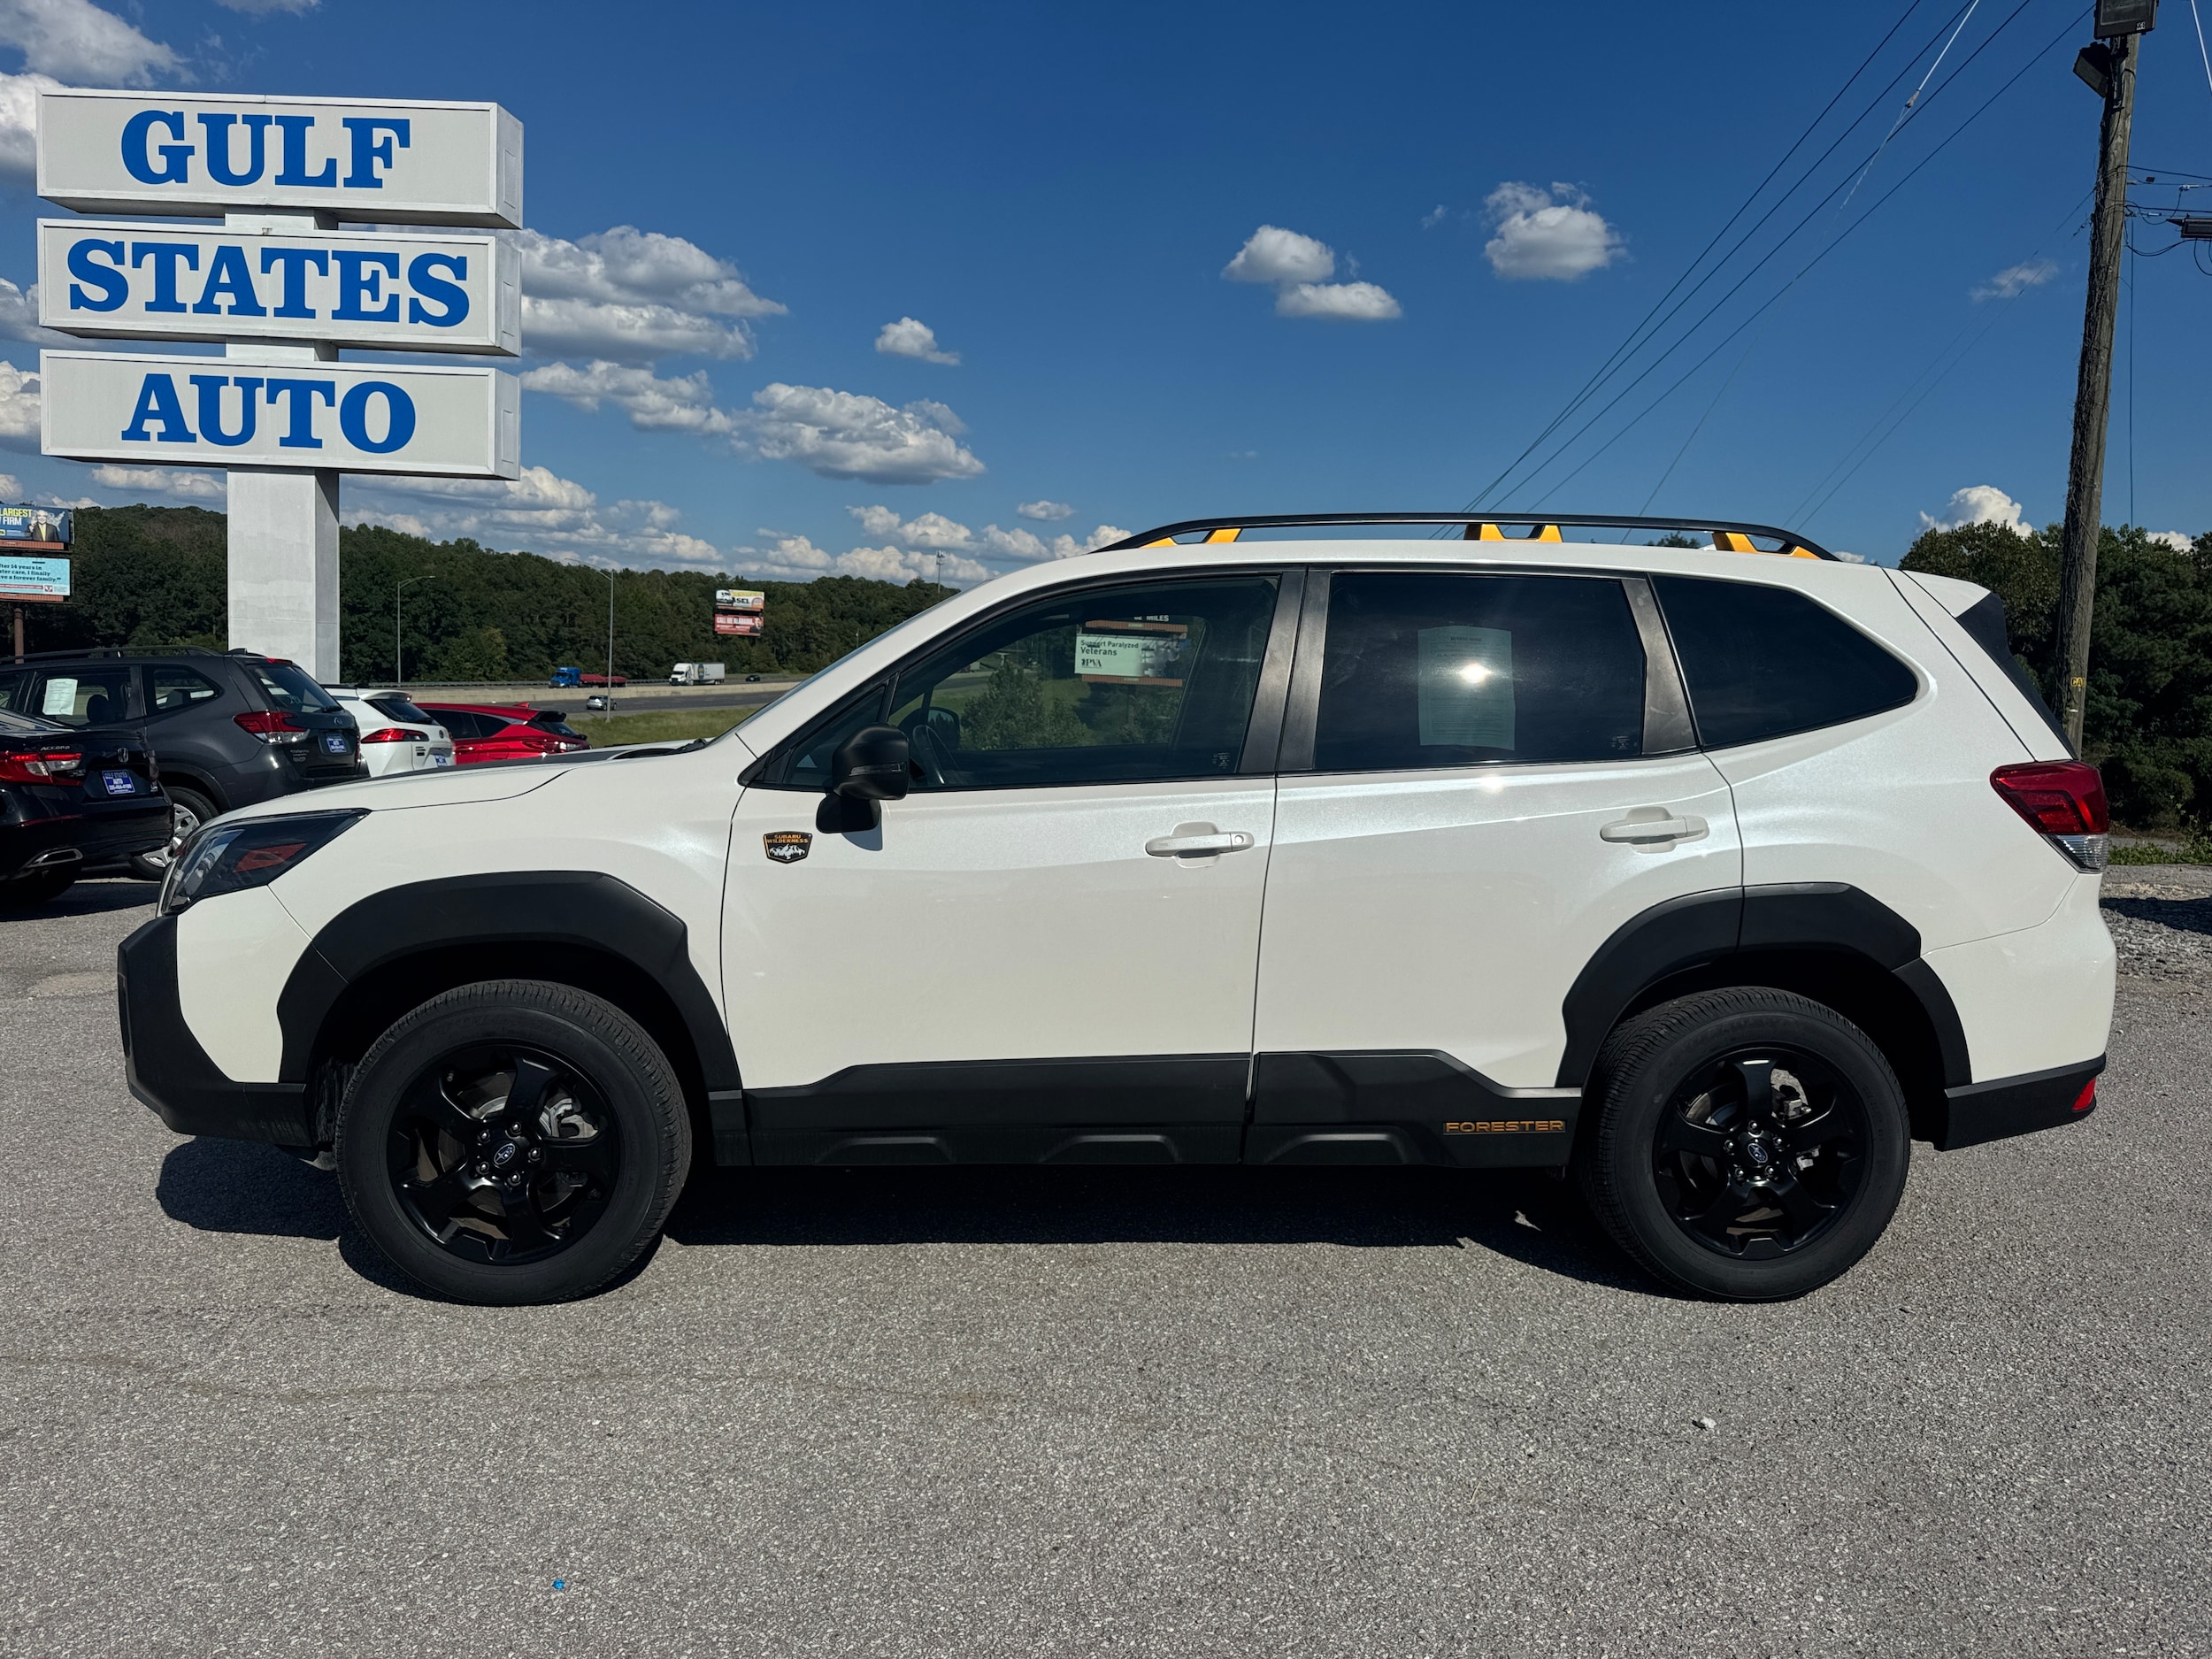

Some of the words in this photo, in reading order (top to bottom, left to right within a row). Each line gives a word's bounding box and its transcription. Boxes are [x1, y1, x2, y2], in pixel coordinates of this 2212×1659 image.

[121, 109, 411, 188] GULF
[67, 238, 470, 327] STATES
[121, 373, 416, 454] AUTO
[3, 517, 22, 526] FIRM
[1080, 646, 1118, 656] Veterans
[1107, 641, 1139, 649] Paralyzed
[1445, 1119, 1564, 1133] FORESTER
